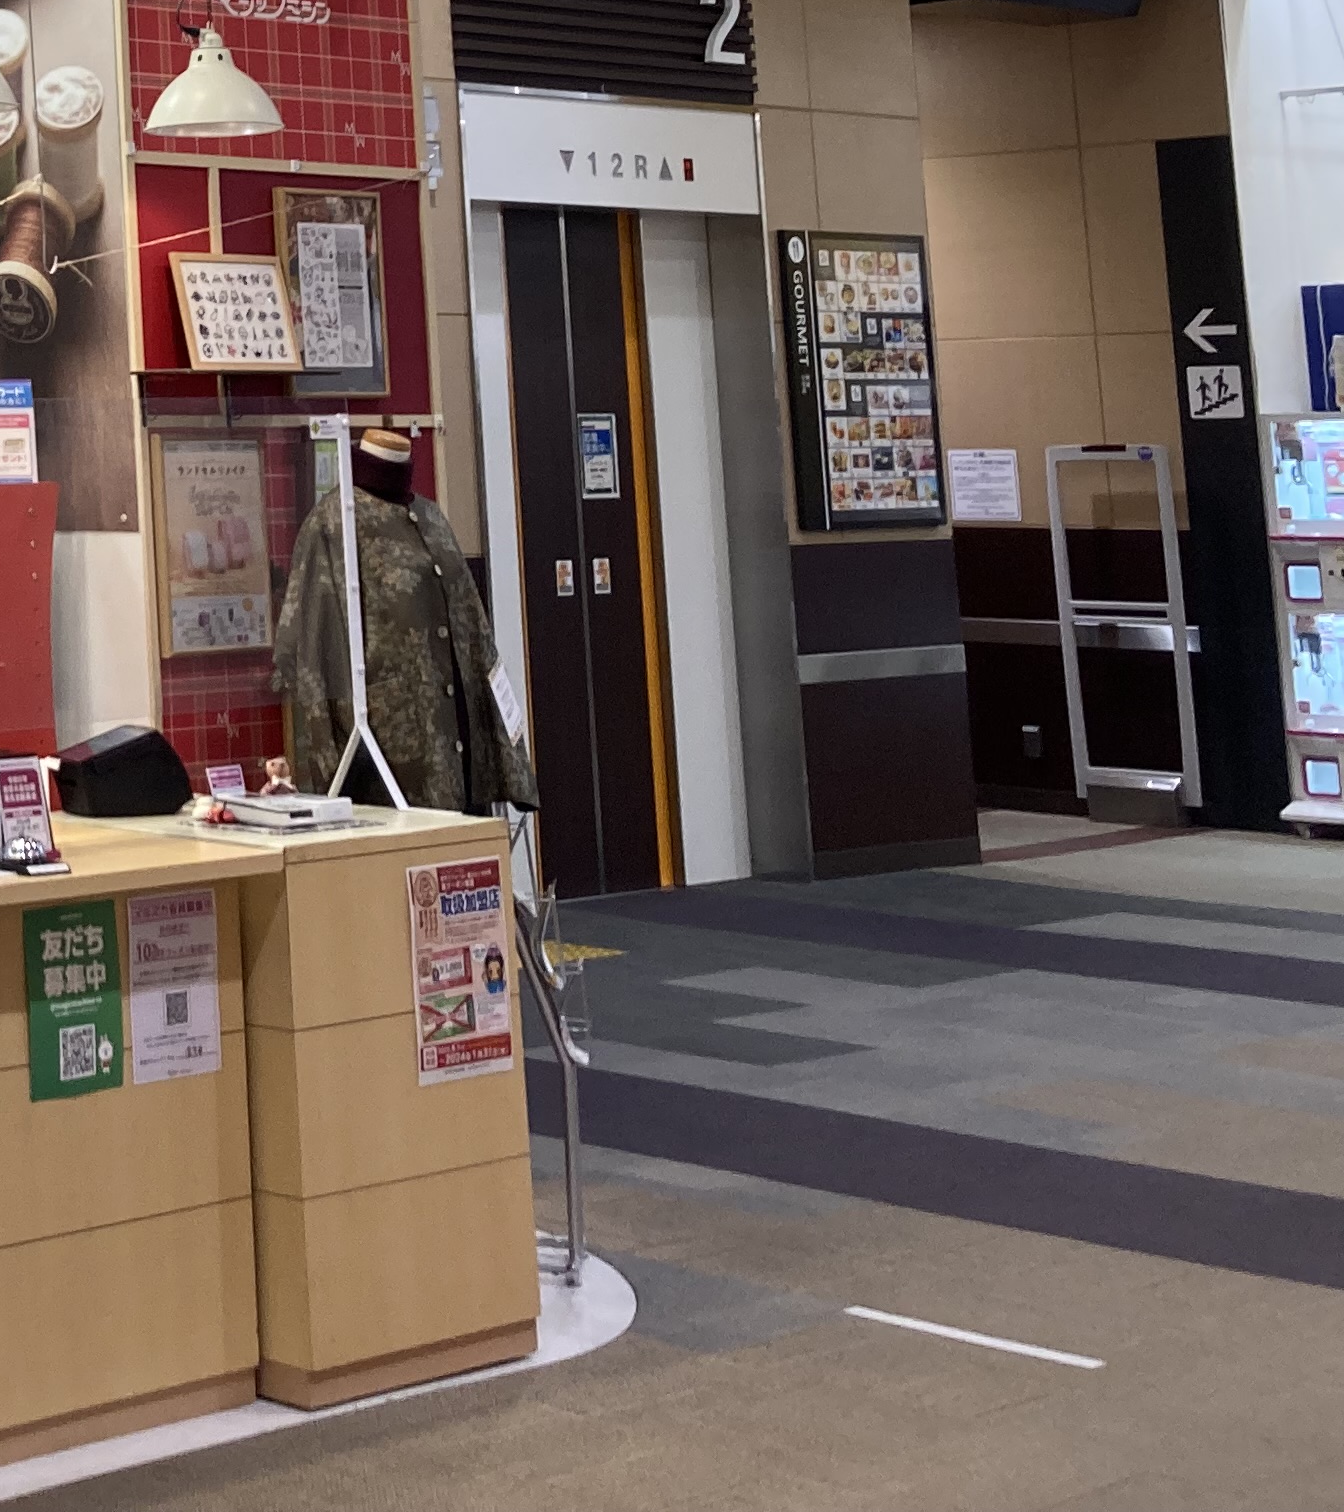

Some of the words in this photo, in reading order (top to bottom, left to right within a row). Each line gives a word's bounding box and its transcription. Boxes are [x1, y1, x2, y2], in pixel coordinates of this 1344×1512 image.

[792, 268, 810, 368] GOURMET
[40, 924, 105, 963] 友だち
